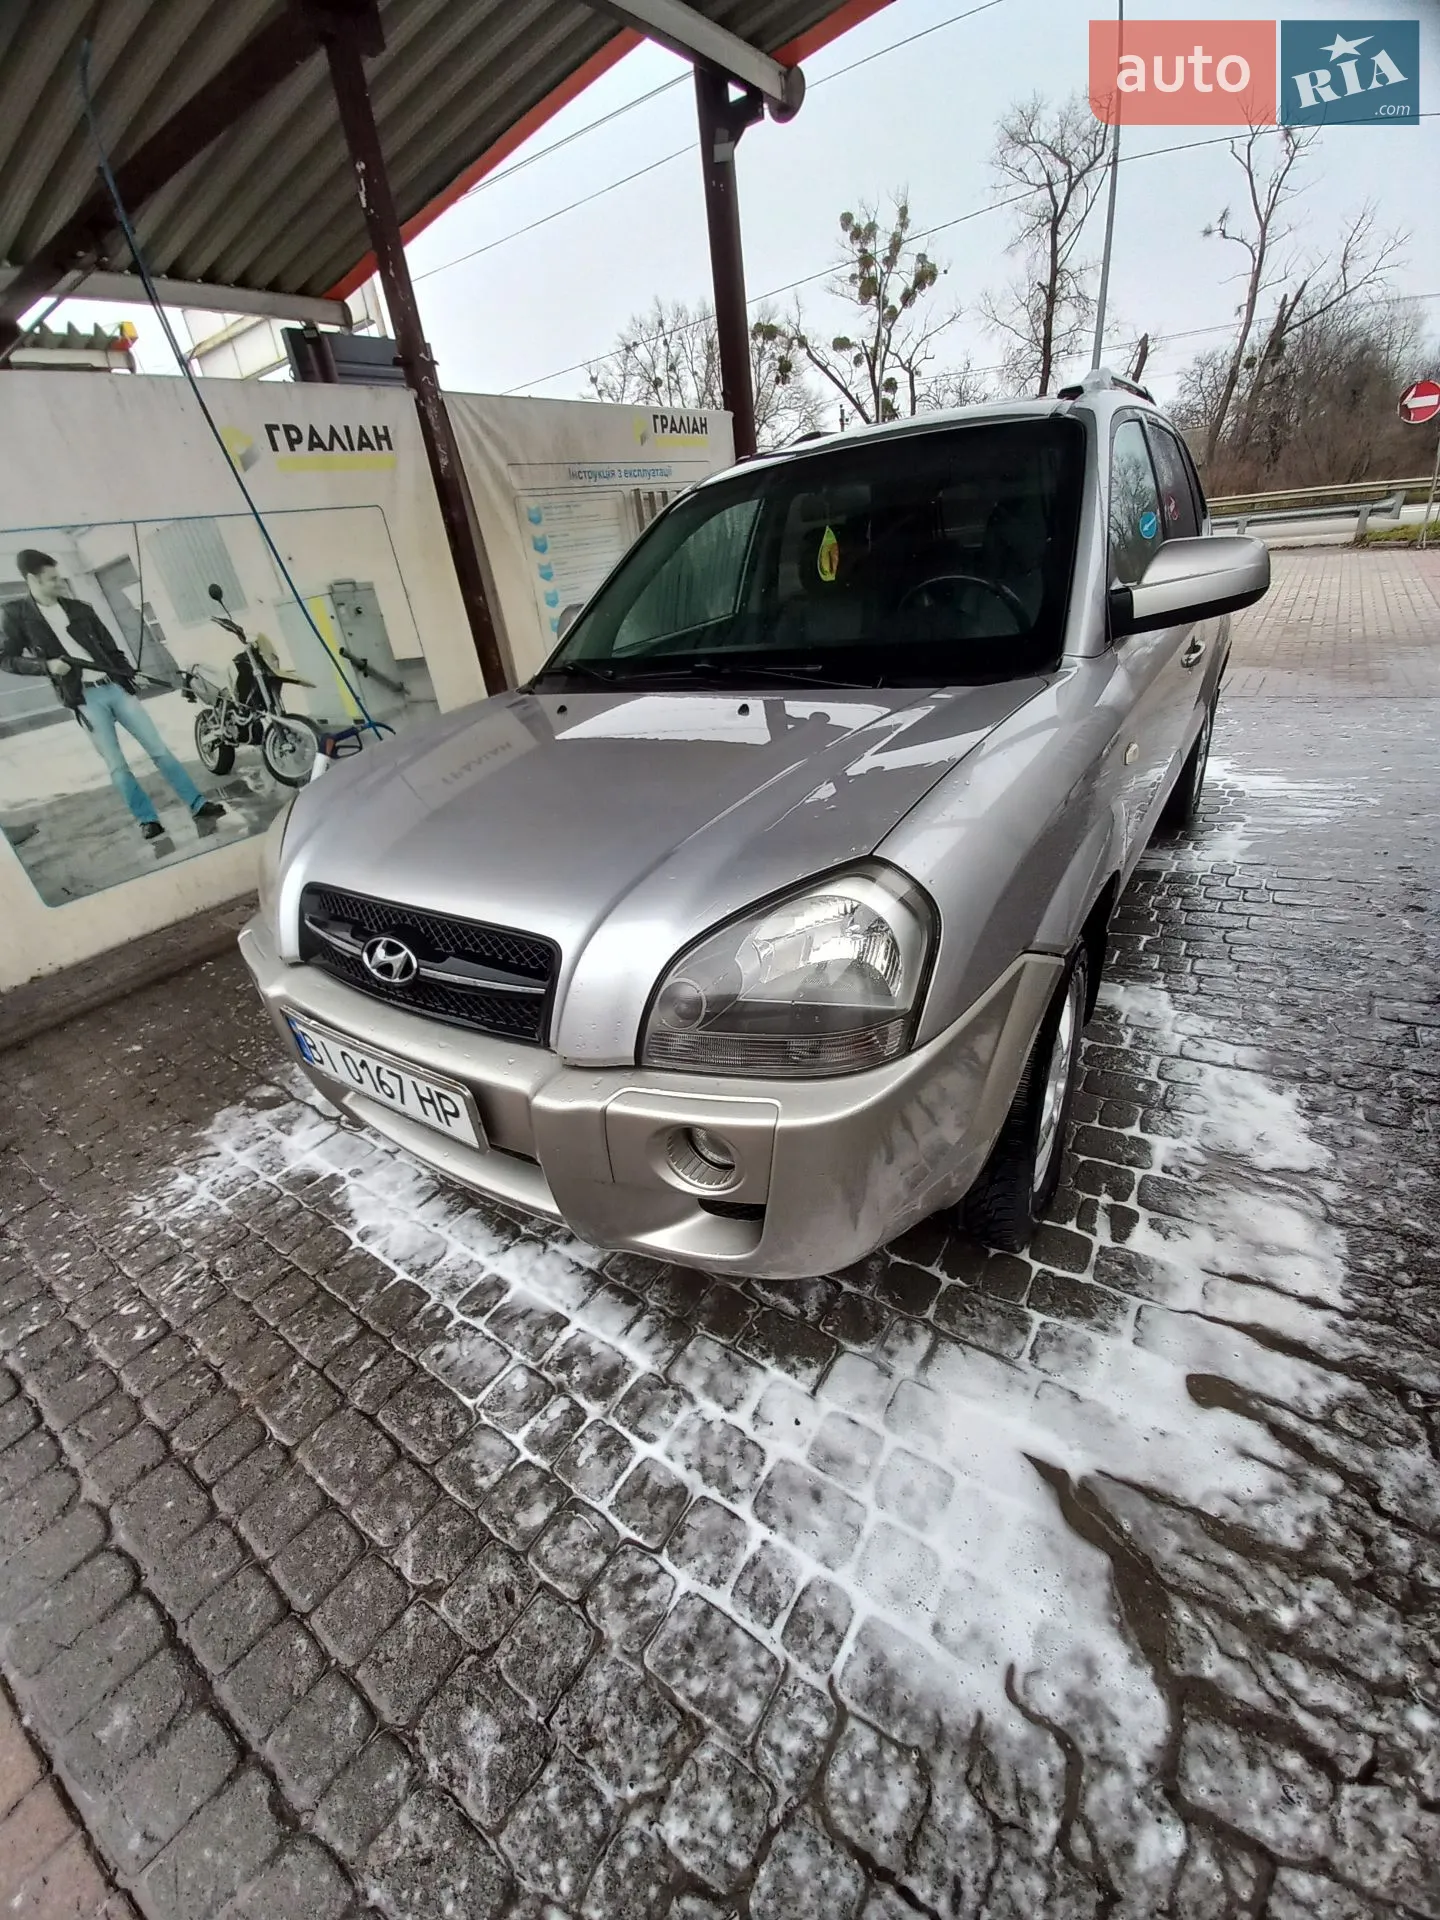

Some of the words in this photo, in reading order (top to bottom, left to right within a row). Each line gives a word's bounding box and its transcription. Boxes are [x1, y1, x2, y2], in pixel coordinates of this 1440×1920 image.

[652, 414, 709, 435] ГРАЛІАН
[264, 423, 394, 452] ГРАЛІАН
[568, 466, 615, 482] Інструкція
[341, 1050, 406, 1105] 0167
